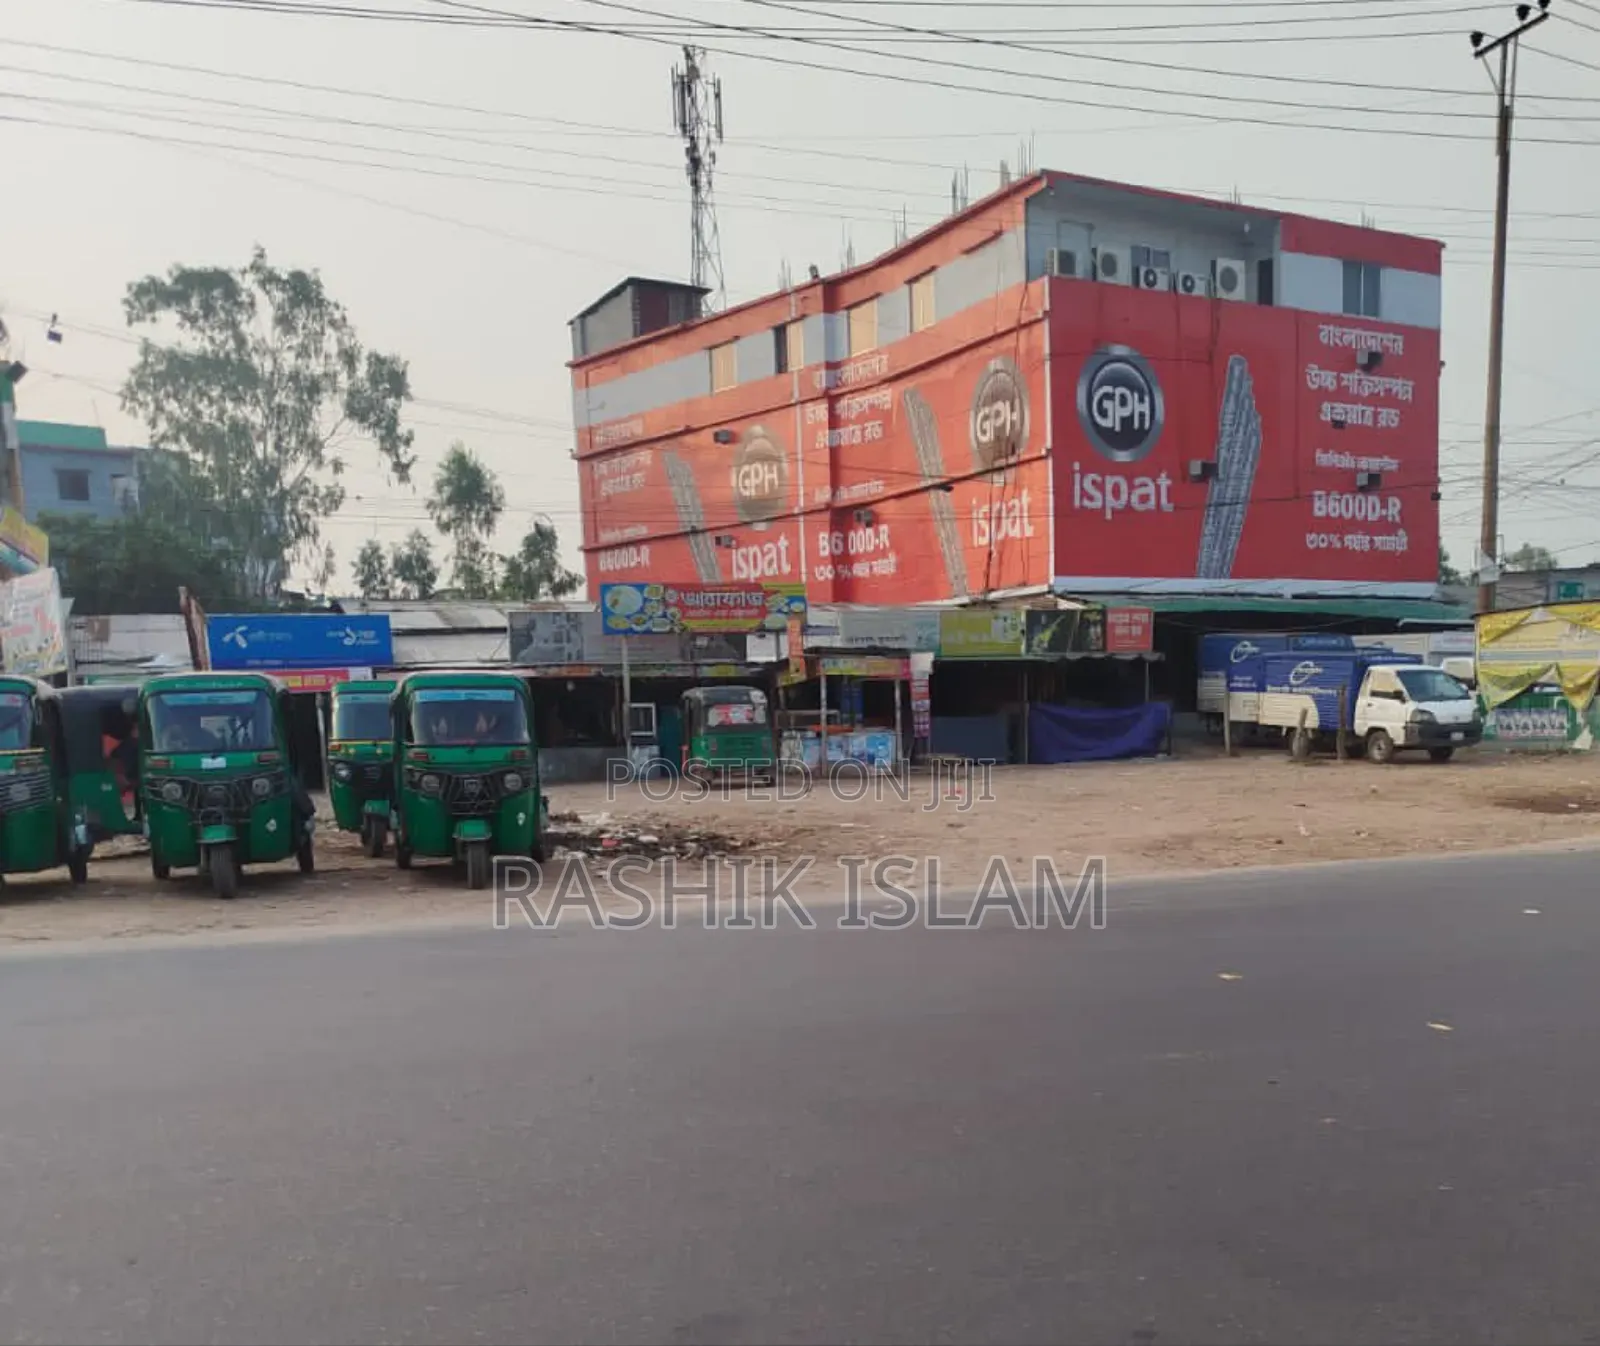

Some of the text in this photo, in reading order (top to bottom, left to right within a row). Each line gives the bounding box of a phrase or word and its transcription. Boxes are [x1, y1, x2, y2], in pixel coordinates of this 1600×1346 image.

[1318, 325, 1404, 356] বাংলাদেশের
[1306, 363, 1337, 391] উচ্চ
[977, 399, 1020, 443] GPH
[1092, 385, 1150, 432] GPH
[1377, 407, 1400, 428] রড
[738, 462, 779, 497] GPH
[1073, 461, 1174, 520] ispat
[971, 487, 1034, 558] ispat
[1312, 490, 1402, 523] B600D-R
[731, 533, 792, 582] ispat
